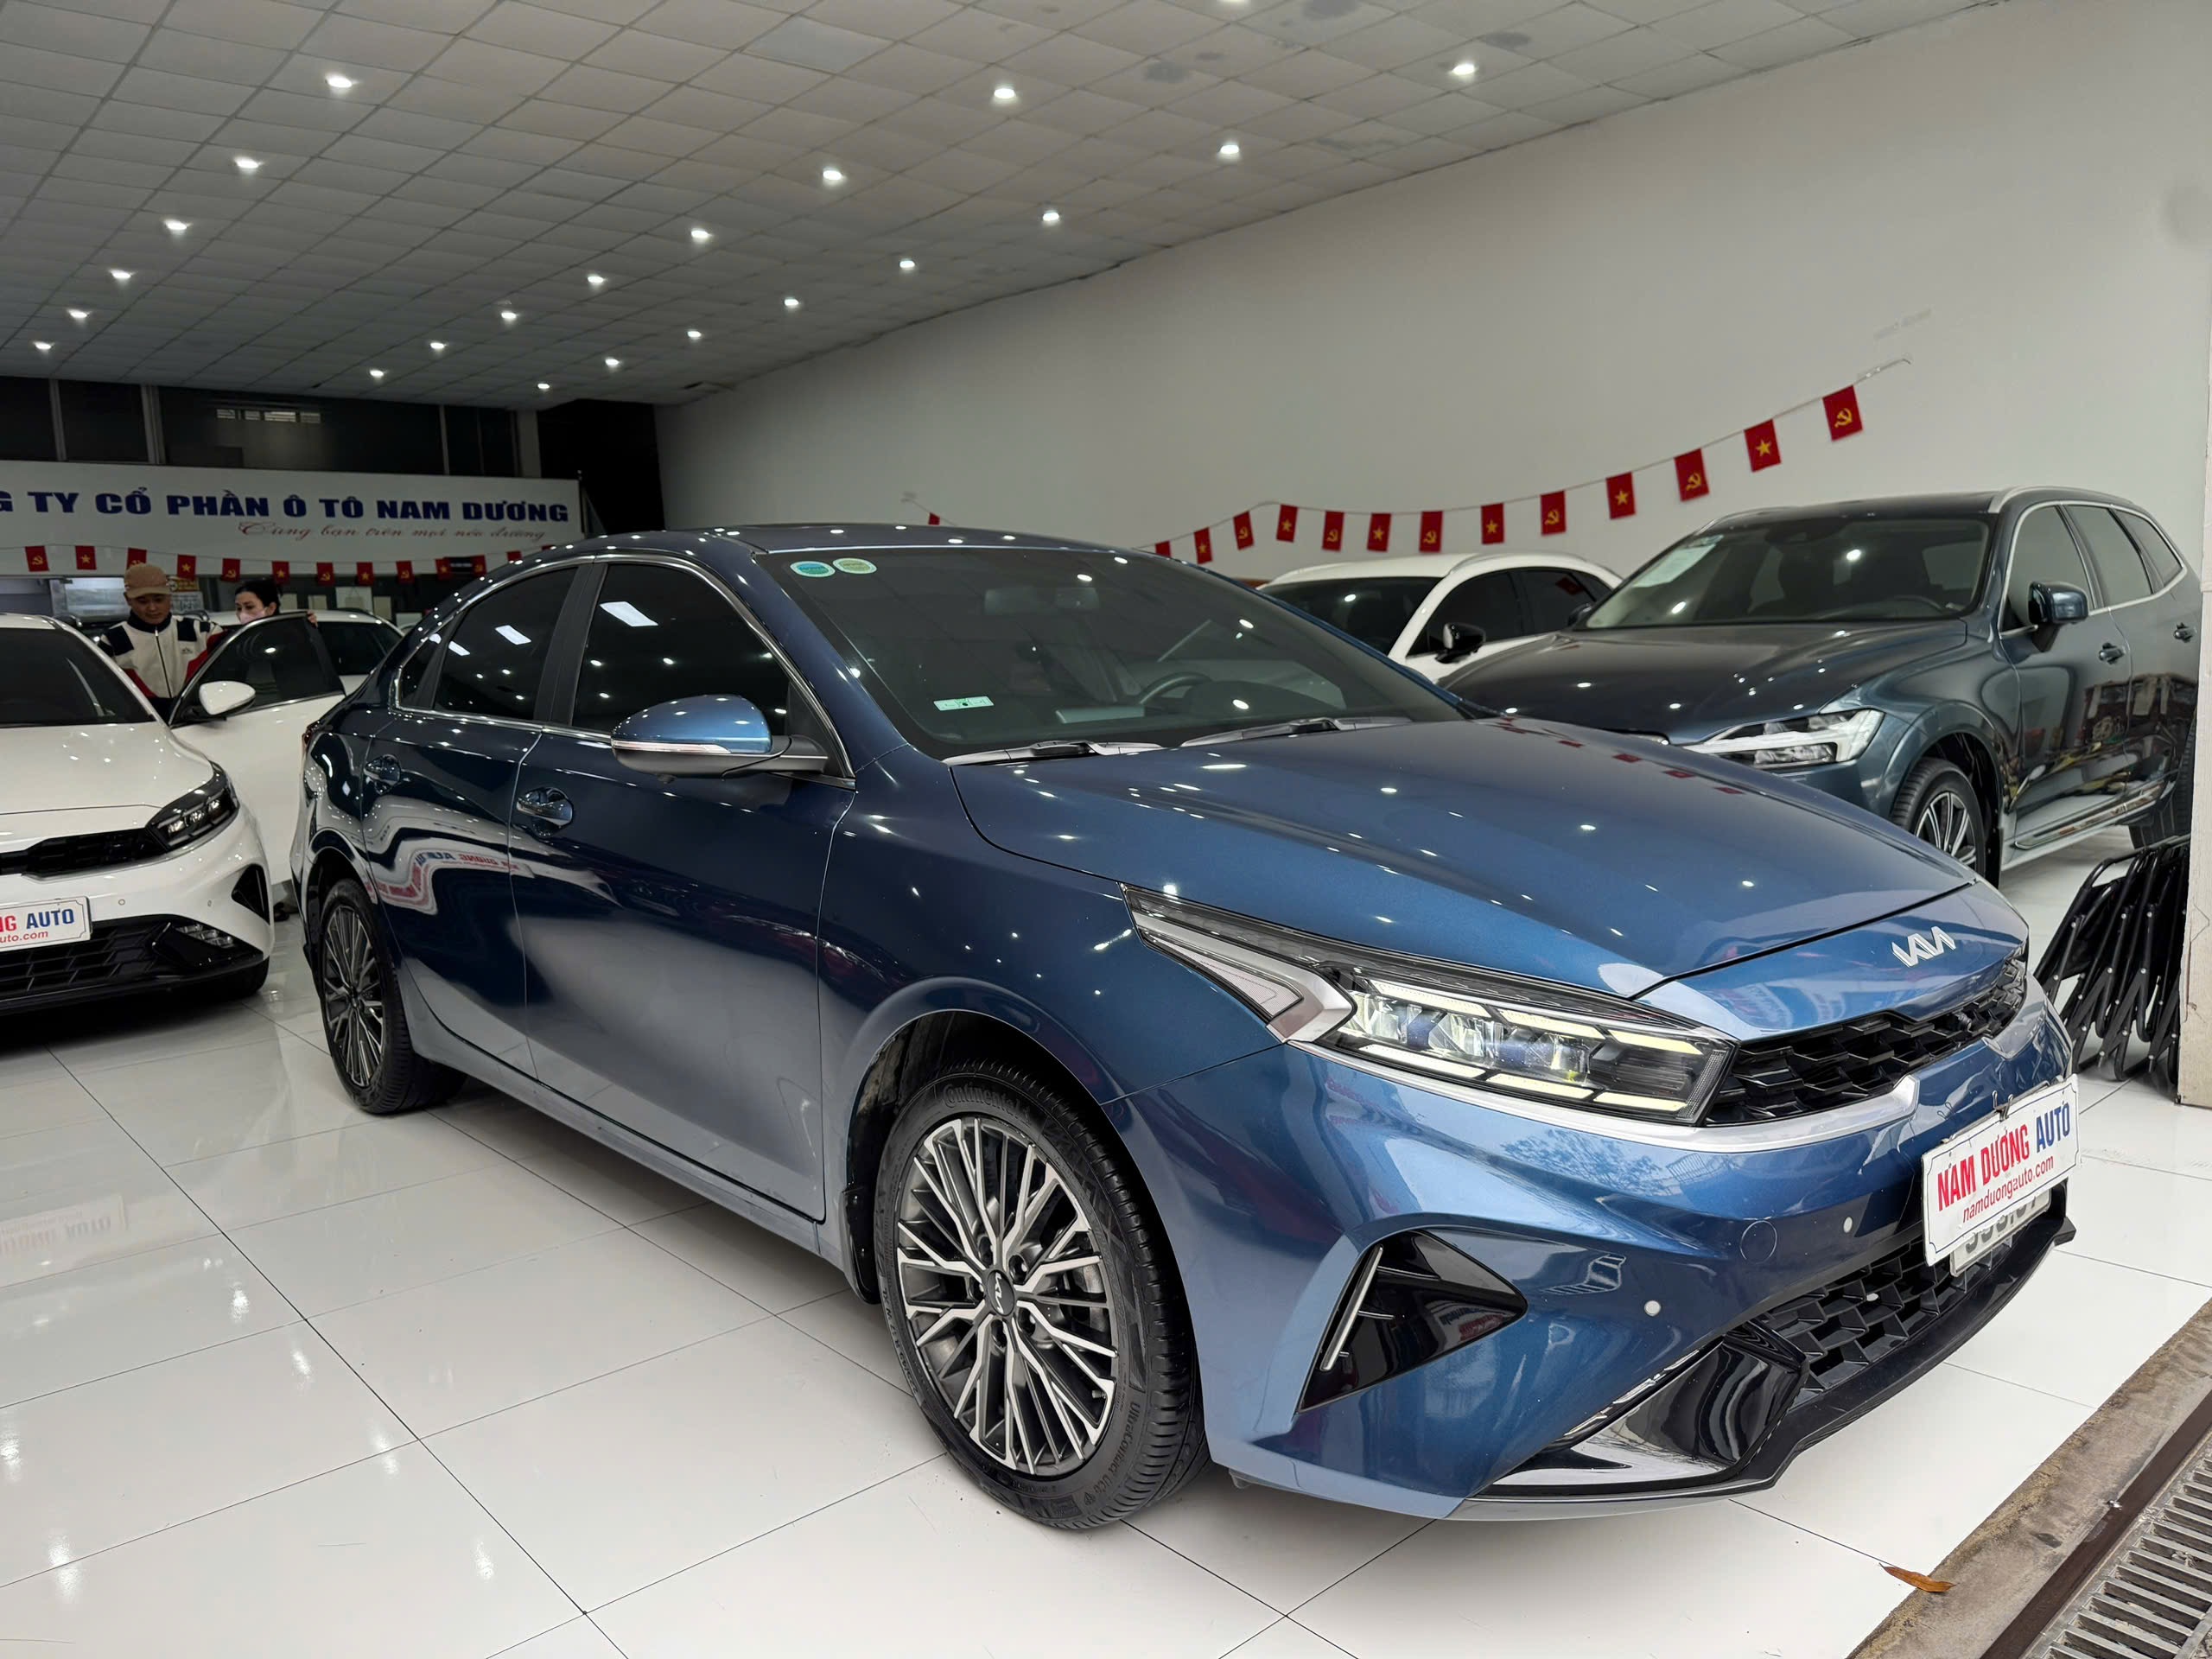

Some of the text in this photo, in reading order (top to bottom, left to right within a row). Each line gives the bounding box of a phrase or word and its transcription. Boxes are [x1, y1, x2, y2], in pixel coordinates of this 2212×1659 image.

[27, 491, 79, 513] TY
[95, 486, 151, 515] CỔ
[167, 489, 270, 517] PHẦN
[283, 494, 307, 518] Ô
[319, 495, 364, 518] TÔ
[377, 499, 451, 520] NAM
[462, 499, 569, 523] DƯƠNG
[26, 908, 75, 930] AUTO
[1937, 1103, 2071, 1212] NAM DƯƠNG AUTO
[1962, 1155, 2054, 1224] namduongauto.com
